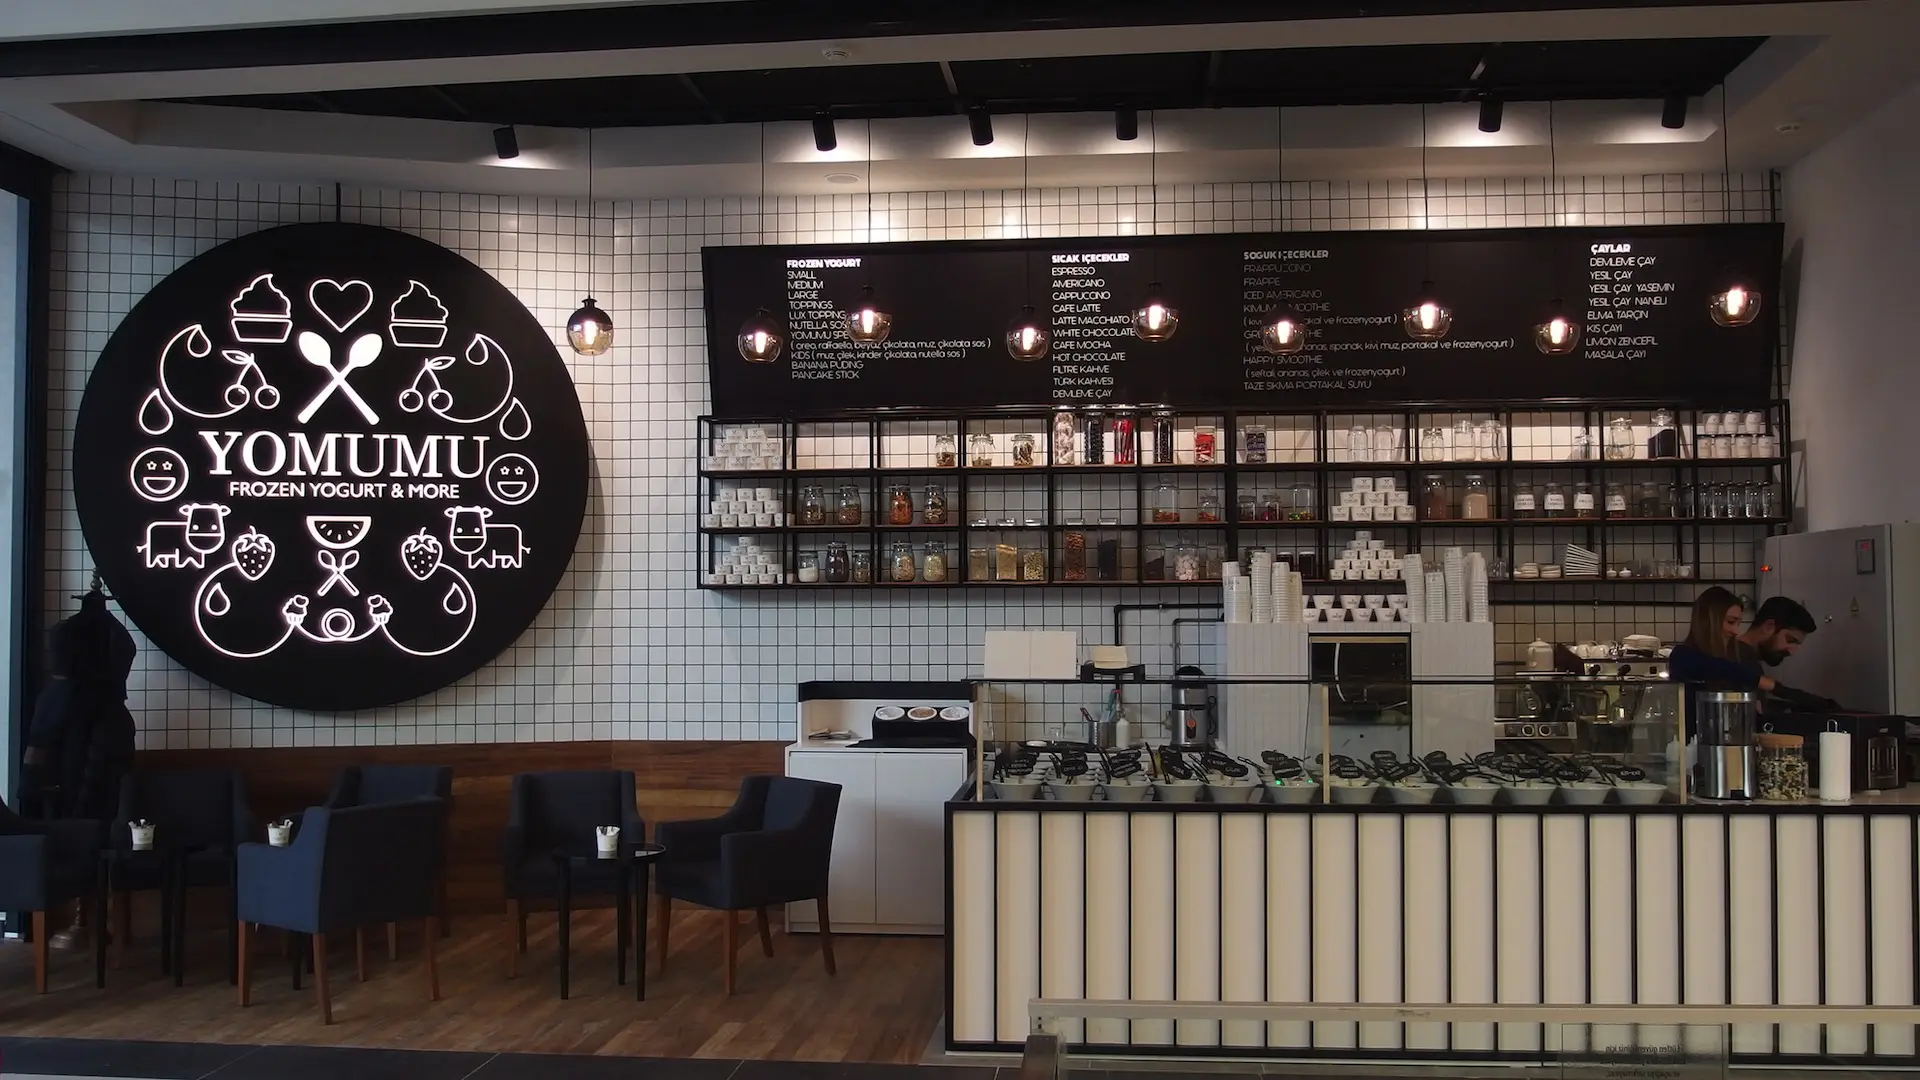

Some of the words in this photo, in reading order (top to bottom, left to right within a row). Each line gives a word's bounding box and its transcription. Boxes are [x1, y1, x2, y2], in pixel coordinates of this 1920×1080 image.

[1591, 243, 1631, 255] ÇAYLAR
[787, 259, 824, 268] FROZEN
[824, 258, 861, 268] YOGURT
[1051, 254, 1080, 263] SICAK
[1589, 257, 1635, 267] DEMLEME
[1637, 256, 1656, 268] ÇAY
[787, 271, 816, 279] SMALL
[1051, 266, 1095, 276] ESPRESSO
[1614, 270, 1633, 281] ÇAY
[788, 281, 824, 289] MEDIUM
[1052, 279, 1105, 288] AMERICANO
[1243, 277, 1281, 286] FRAPPE
[1613, 283, 1632, 295] ÇAY
[788, 291, 818, 300] LARGE
[1052, 291, 1111, 300] CAPPUCCINO
[1243, 291, 1264, 300] ICED
[789, 300, 833, 310] TOPPINGS
[1612, 297, 1631, 308] ÇAY
[1052, 304, 1075, 313] CAFE
[1076, 304, 1101, 312] LATTE
[789, 311, 806, 320] LUX
[808, 310, 846, 319] TOPPING
[1587, 311, 1614, 320] ELMA
[789, 321, 829, 330] NUTELLA
[1052, 316, 1077, 325] LATTE
[1078, 316, 1130, 325] MACCHIATO
[1052, 329, 1080, 337] WHITE
[1082, 328, 1135, 337] CHOCOLATE
[1602, 324, 1623, 335] ÇAYI
[790, 331, 832, 340] YOMUMU
[1053, 341, 1075, 350] CAFE
[1076, 340, 1111, 349] MOCHA
[1401, 340, 1438, 351] portakal
[1453, 340, 1508, 350] frozenyogurt
[1585, 337, 1617, 346] LIMON
[791, 351, 810, 359] KIDS
[857, 350, 882, 359] kinder
[1052, 353, 1071, 362] HOT
[1072, 352, 1126, 361] CHOCOLATE
[1584, 350, 1624, 359] MASALA
[1626, 350, 1647, 360] ÇAYI
[791, 361, 828, 369] BANANA
[1243, 356, 1275, 364] HAPPY
[1052, 365, 1078, 374] FILTRE
[1079, 365, 1110, 373] KAHVE
[1345, 367, 1400, 378] frozenyogurt
[792, 371, 833, 380] PANCAKE
[835, 370, 859, 379] STICK
[1053, 376, 1076, 386] TÜRK
[1244, 381, 1265, 390] TAZE
[1296, 380, 1346, 389] PORTAKAL
[1348, 380, 1372, 389] SUYU
[1052, 389, 1093, 398] DEMLEME
[1095, 389, 1112, 399] ÇAY
[198, 430, 491, 478] YOMUMU
[229, 481, 305, 497] FROZEN
[308, 482, 387, 498] YOGURT
[390, 483, 405, 498] &
[408, 483, 460, 499] MORE
